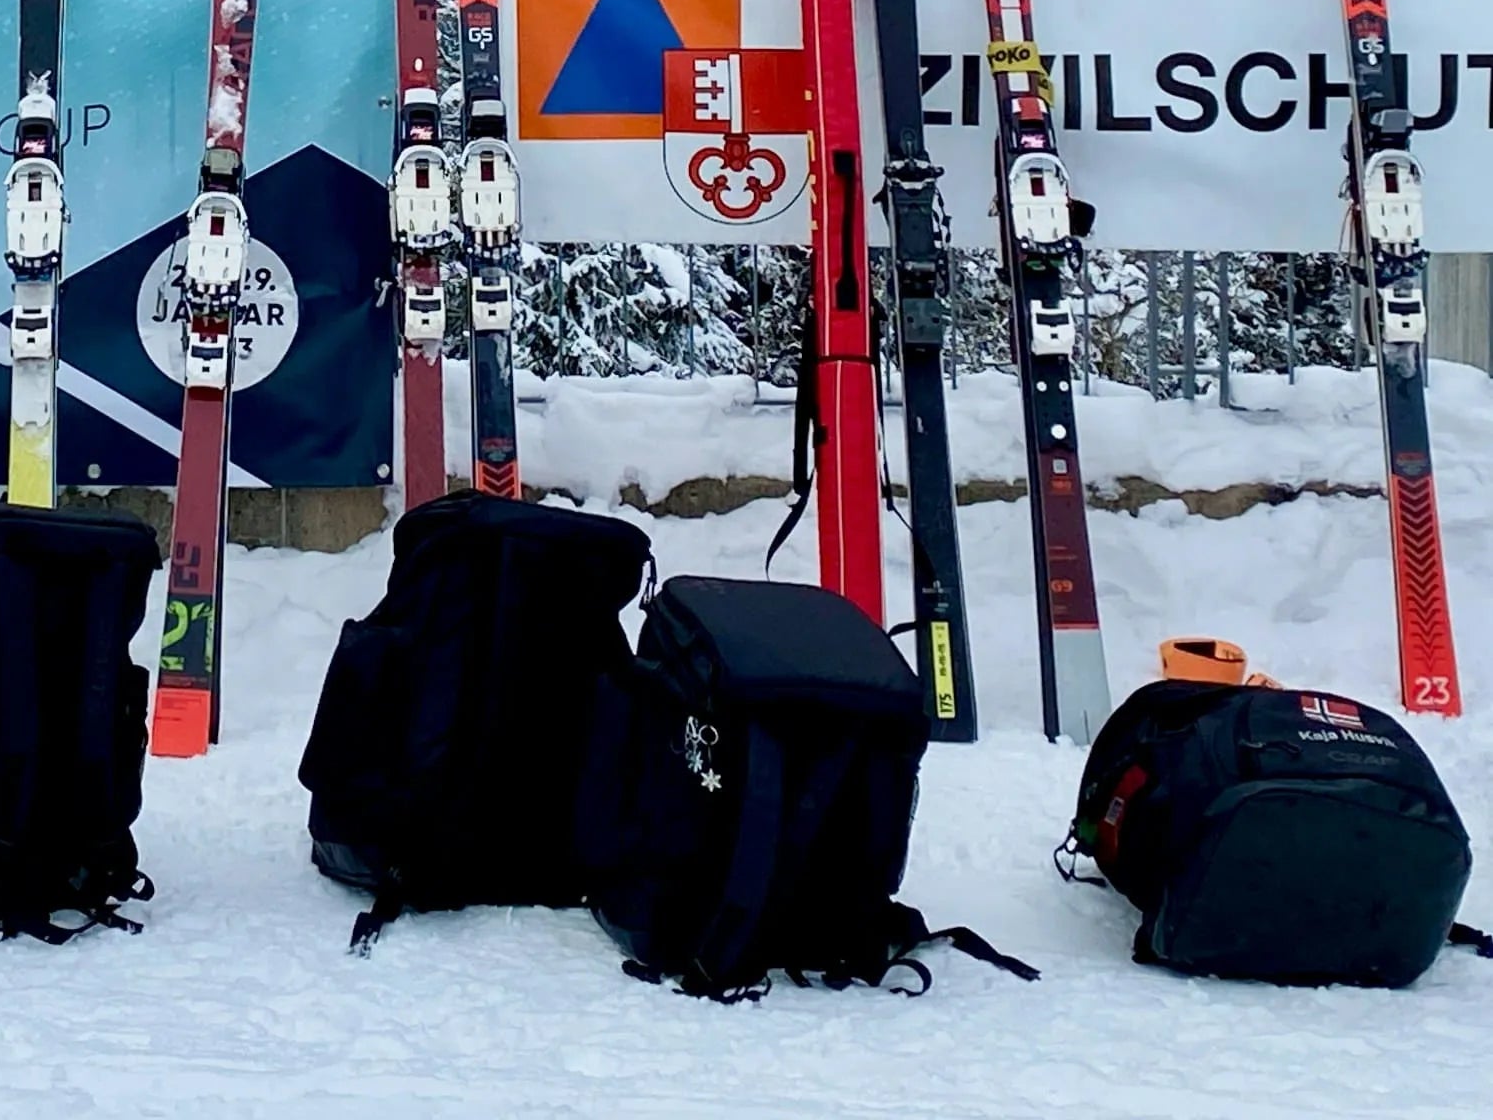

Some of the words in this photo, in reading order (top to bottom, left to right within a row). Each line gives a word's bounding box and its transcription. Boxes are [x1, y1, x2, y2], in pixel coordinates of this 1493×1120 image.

[468, 27, 493, 42] GS
[1415, 676, 1451, 706] 23
[1298, 729, 1339, 743] Kaja
